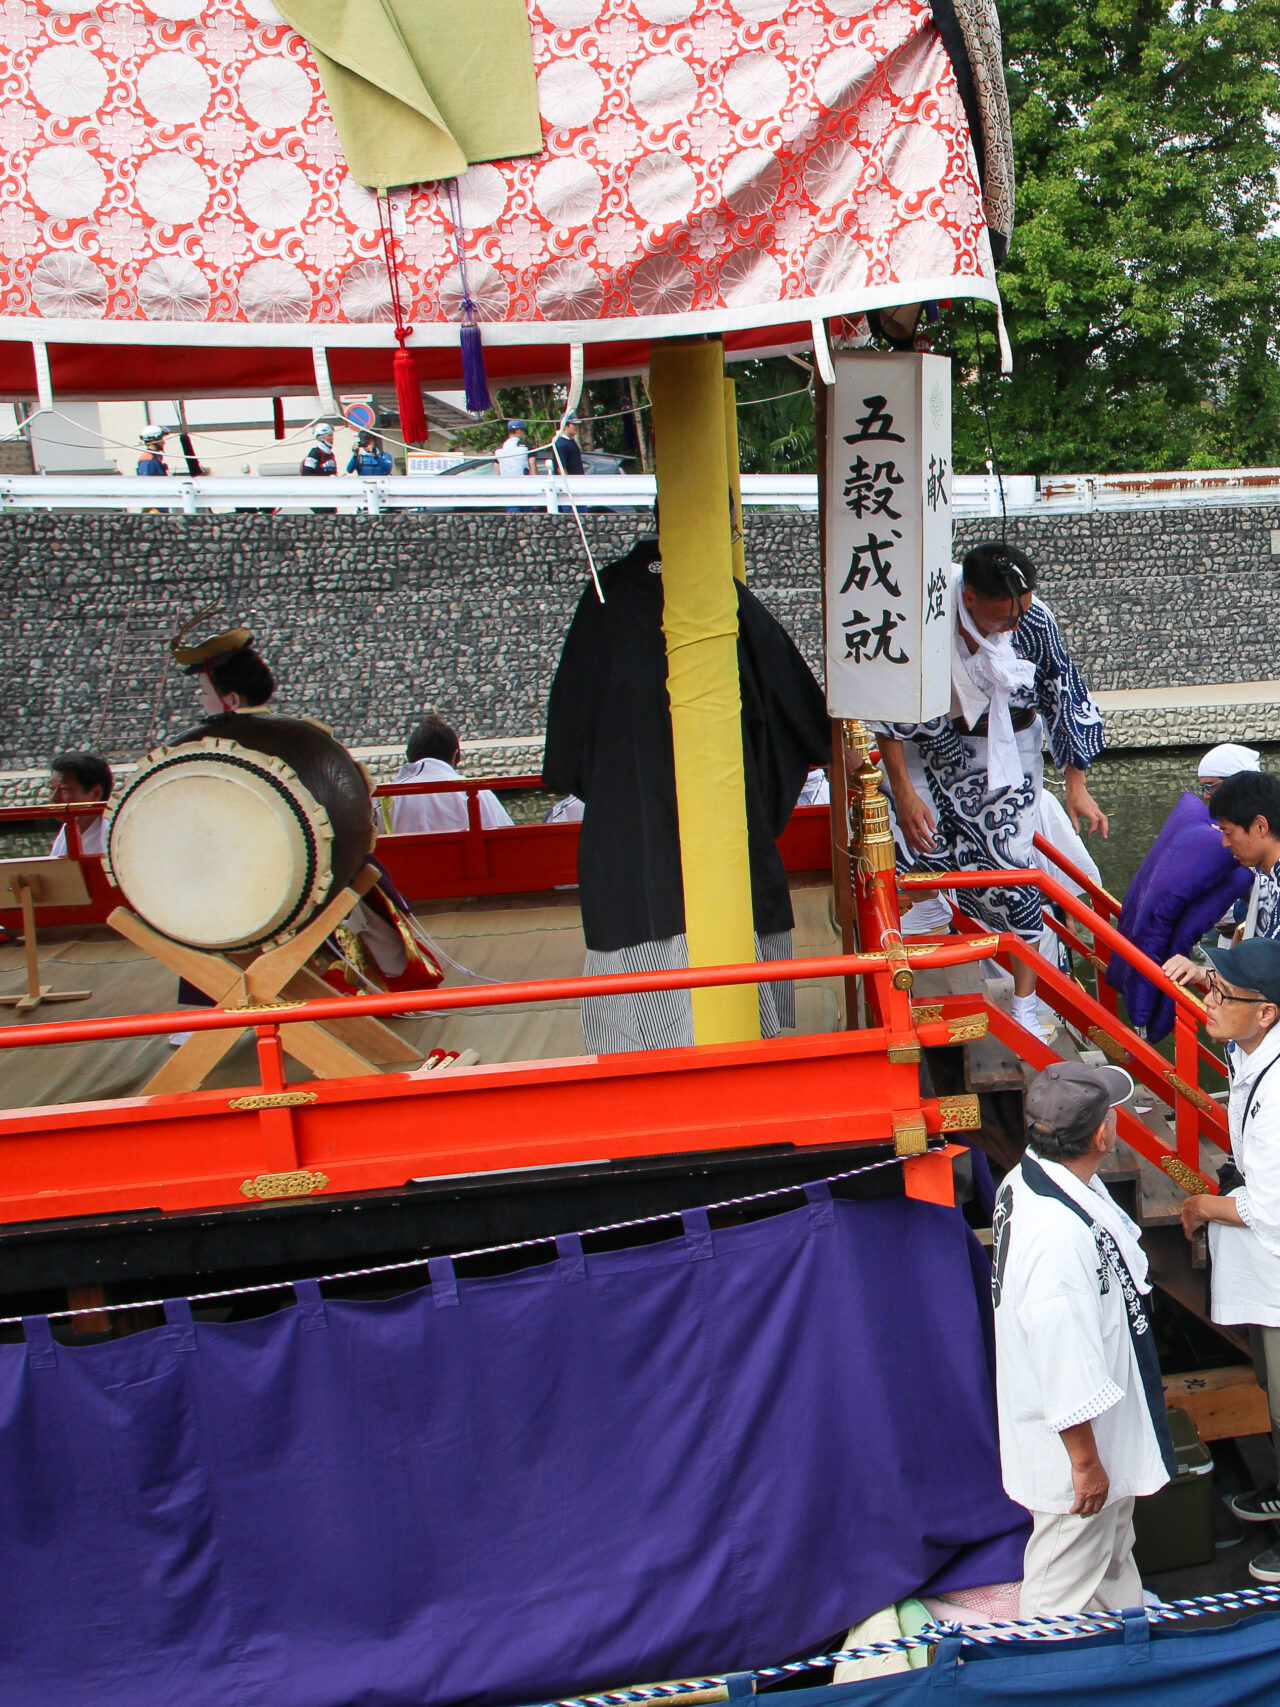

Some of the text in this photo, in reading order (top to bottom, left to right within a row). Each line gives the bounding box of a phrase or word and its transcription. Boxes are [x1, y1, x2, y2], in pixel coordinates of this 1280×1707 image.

[838, 394, 910, 665] 五穀成就
[926, 452, 949, 625] 献燈
